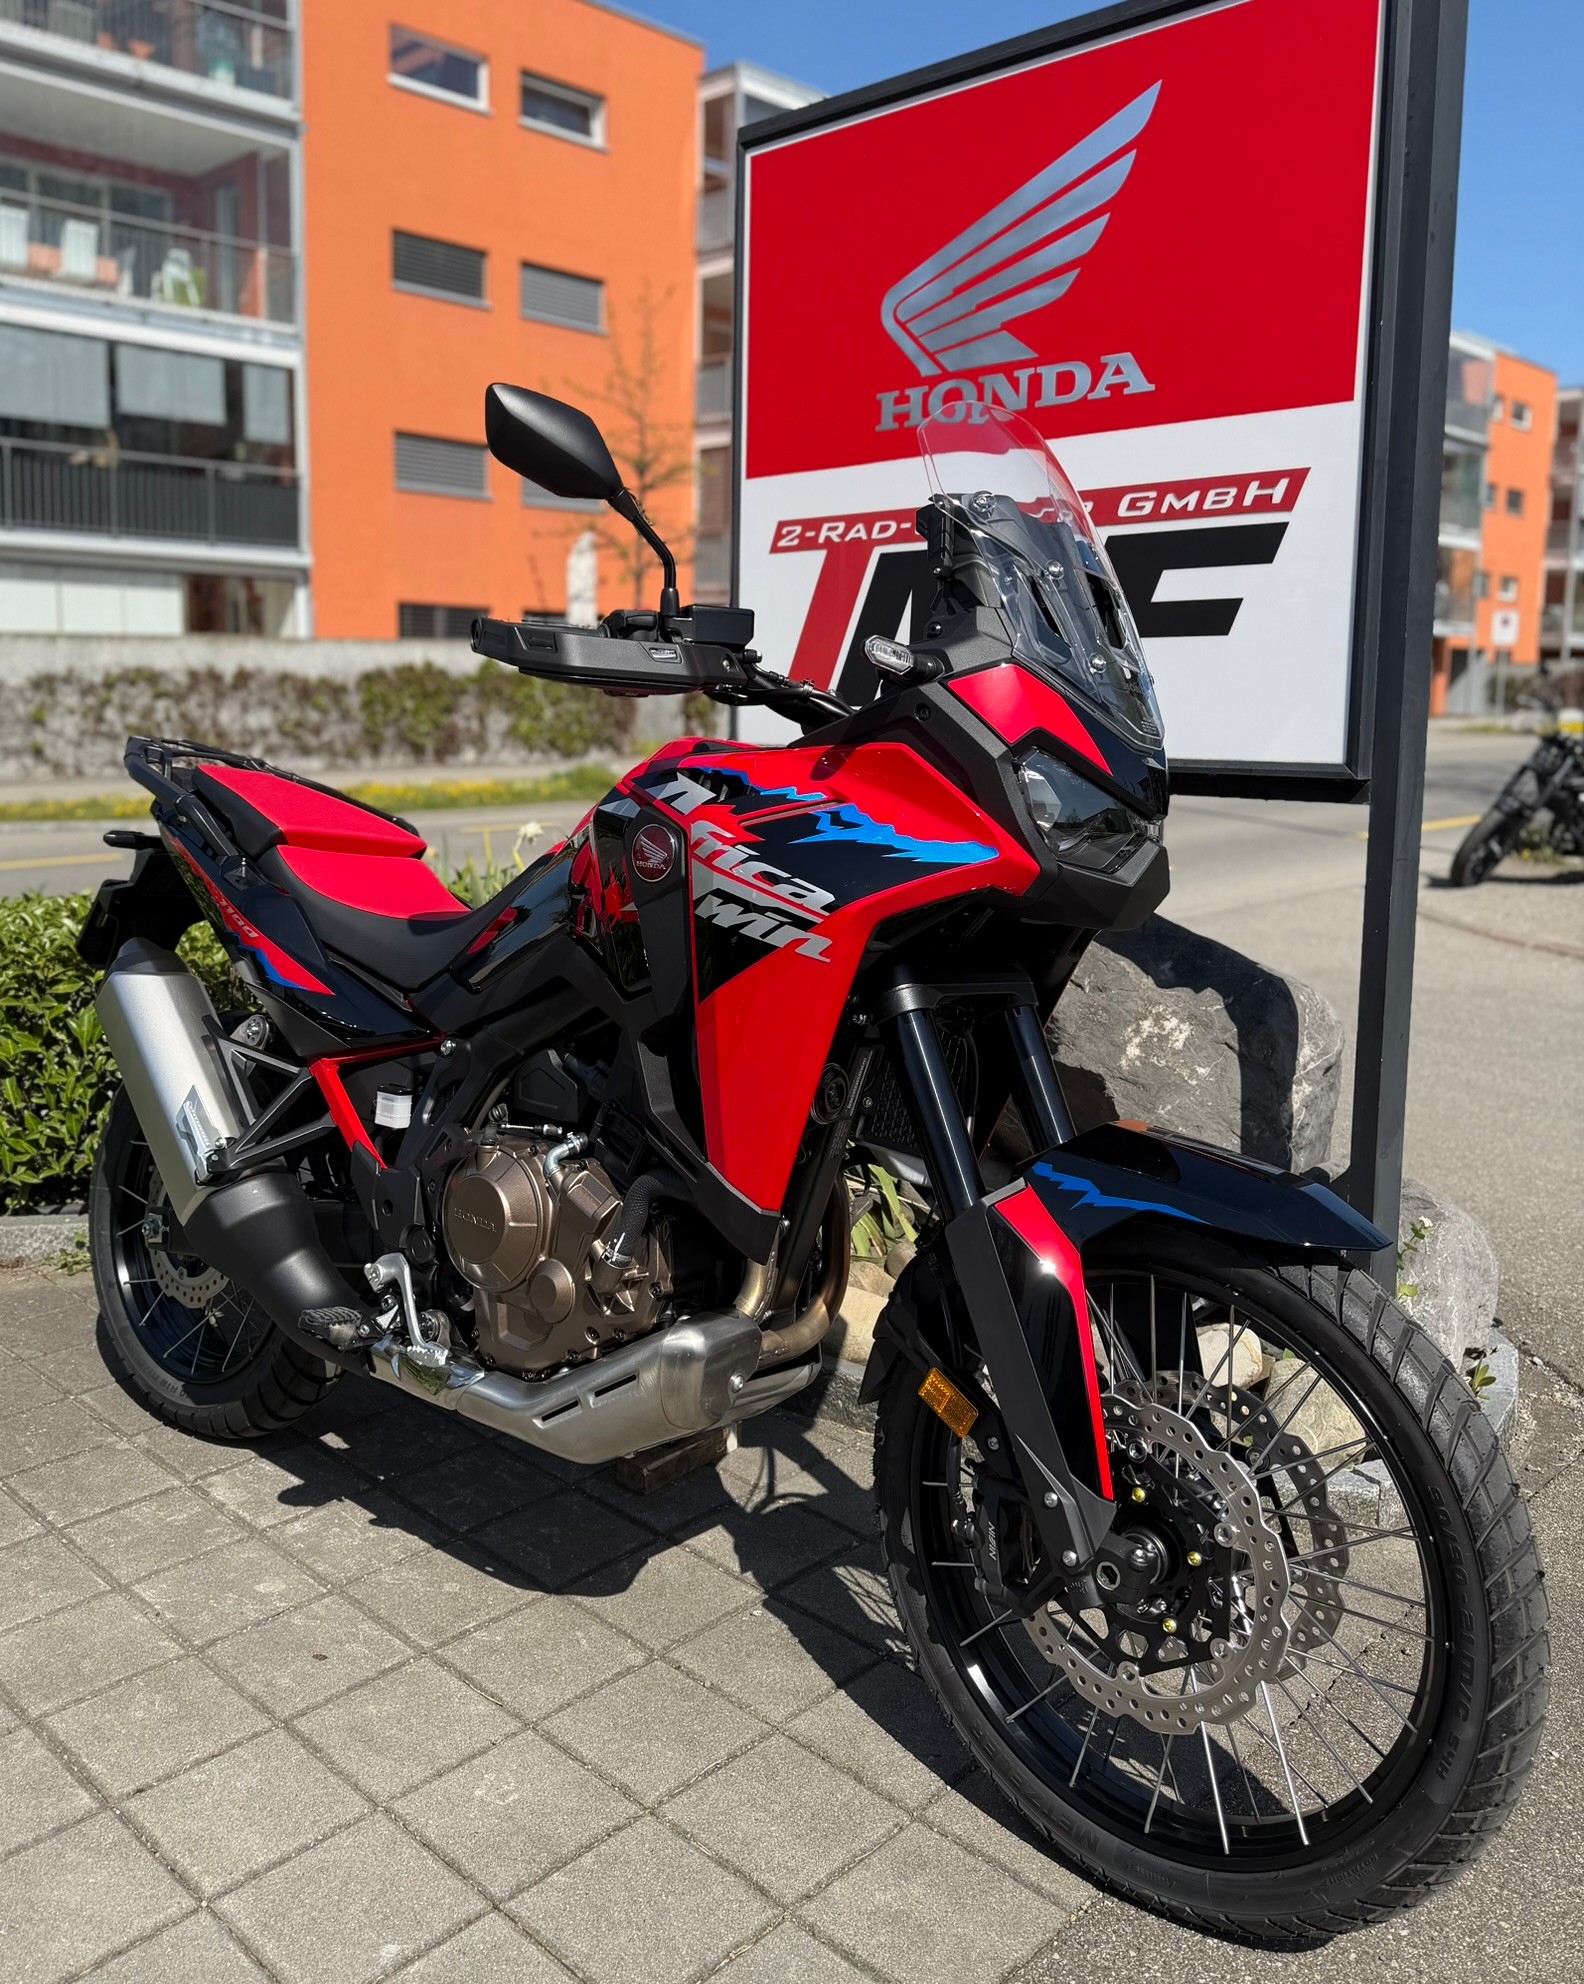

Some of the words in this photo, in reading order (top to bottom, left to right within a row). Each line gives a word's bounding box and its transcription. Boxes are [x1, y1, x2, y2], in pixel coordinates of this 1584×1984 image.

[875, 352, 1156, 432] HONDA
[636, 860, 667, 870] HONDA
[453, 1207, 497, 1233] HONDA
